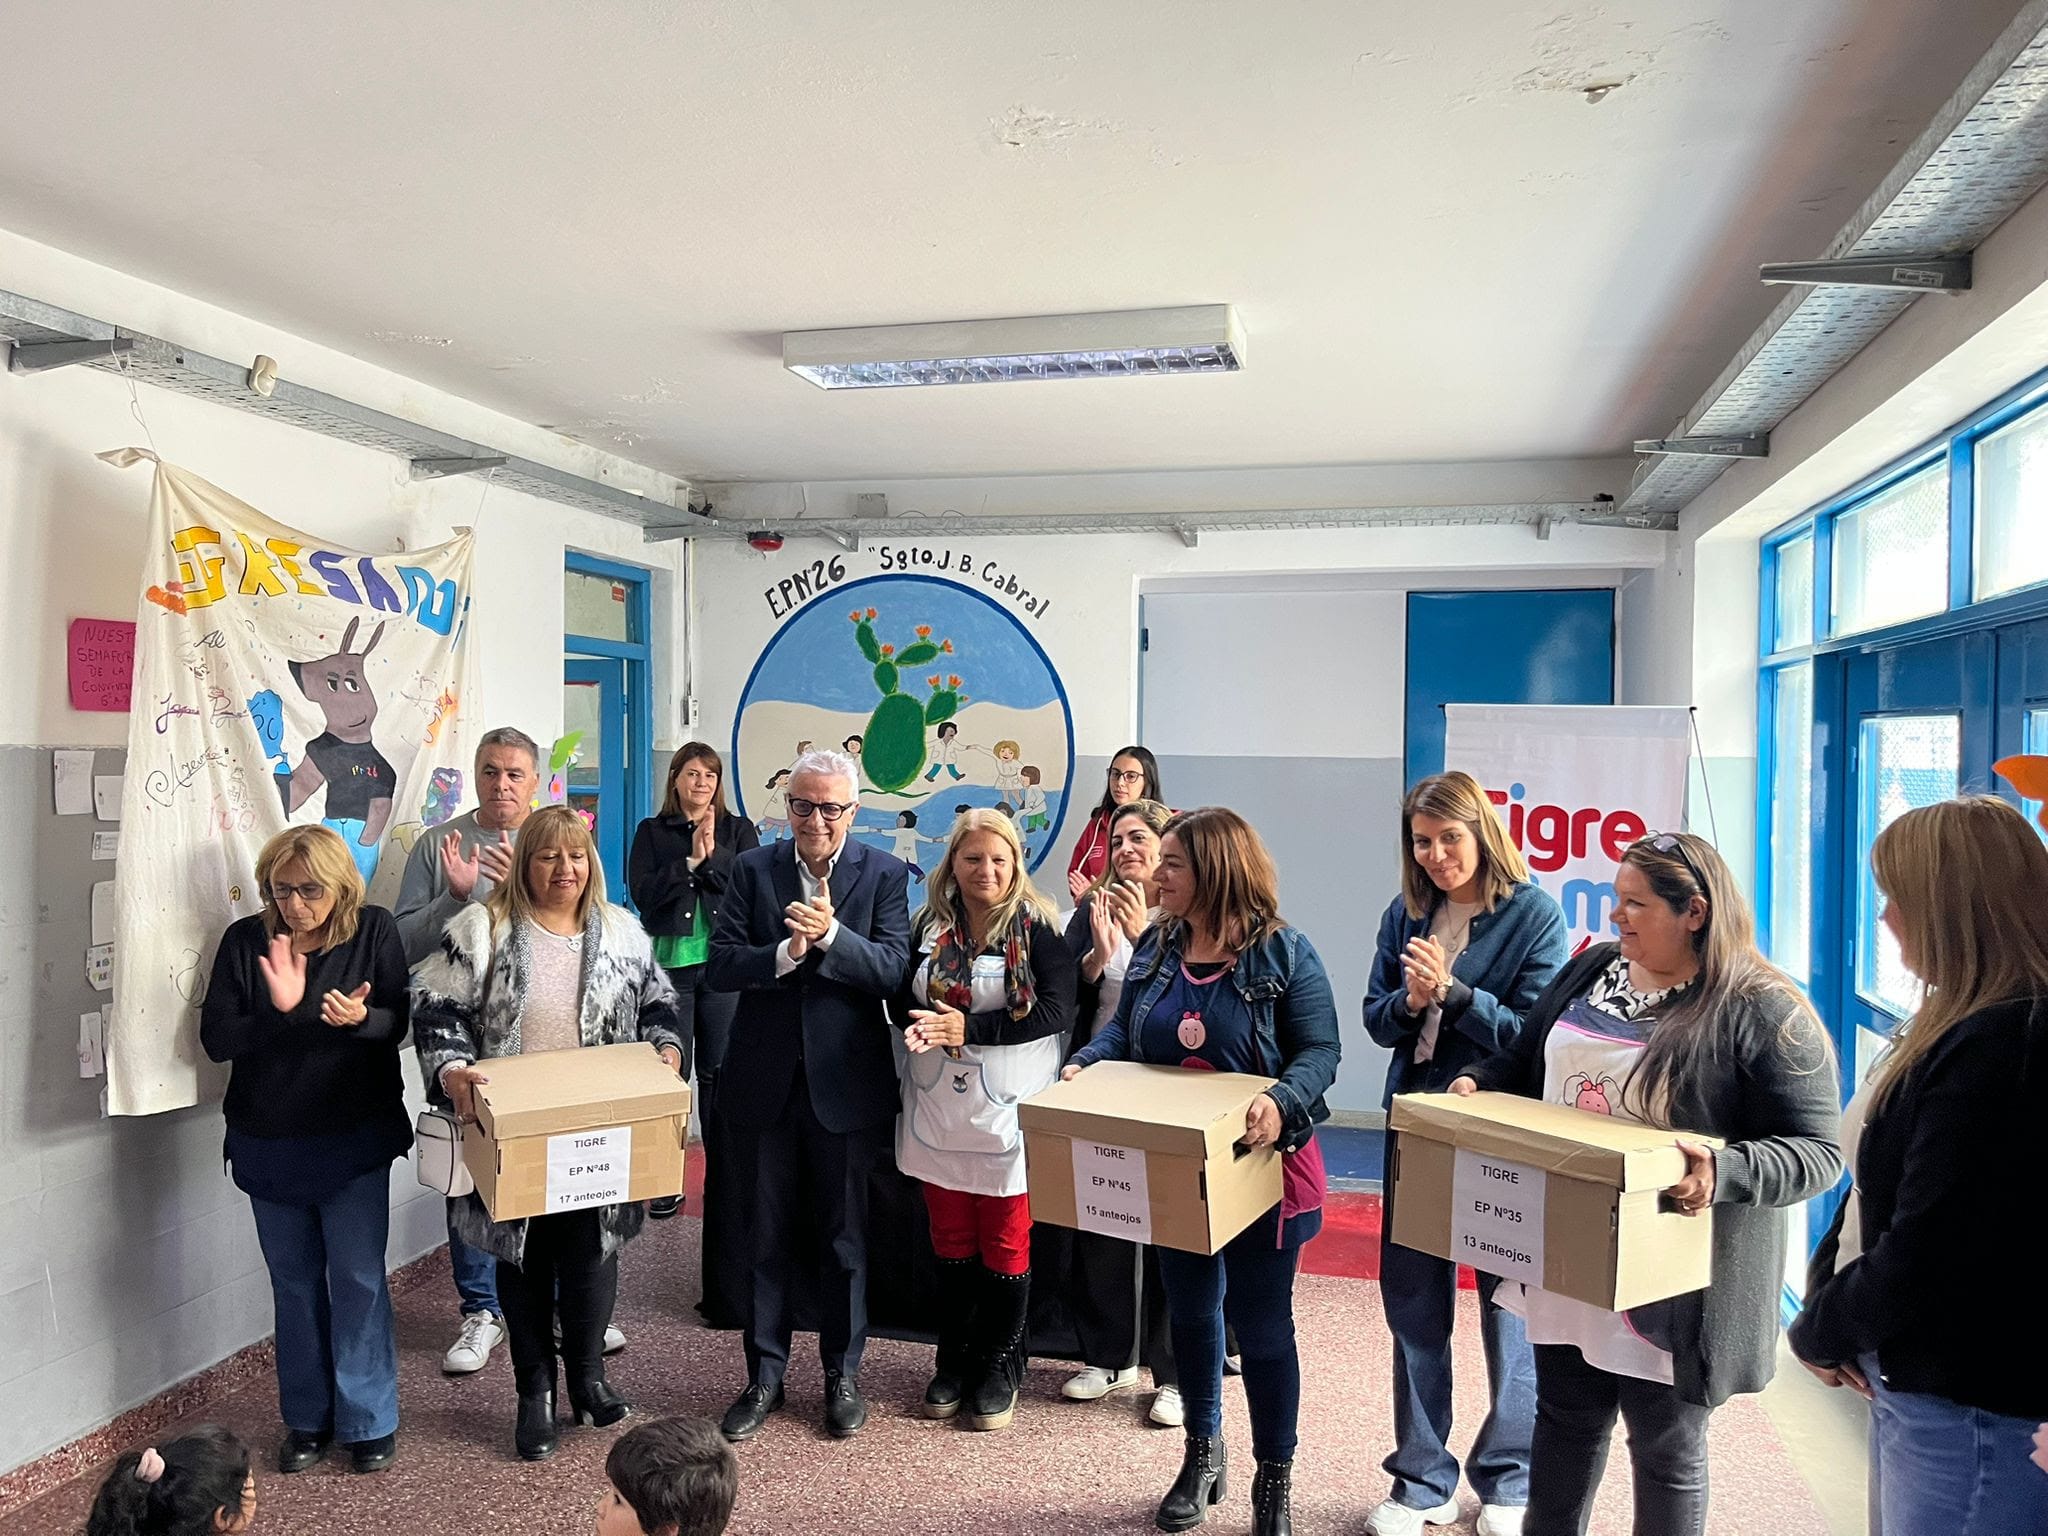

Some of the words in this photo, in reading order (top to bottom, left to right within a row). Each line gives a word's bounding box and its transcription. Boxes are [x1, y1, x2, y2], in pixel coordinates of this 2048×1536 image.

[982, 562, 1050, 619] Cabral
[87, 664, 103, 677] DE
[112, 667, 125, 675] LA
[1484, 782, 1647, 872] igre
[574, 1137, 607, 1148] TIGRE
[1094, 1146, 1125, 1160] TIGRE
[569, 1166, 583, 1176] EP
[1481, 1165, 1519, 1184] TIGRE
[1092, 1176, 1105, 1186] EP
[560, 1195, 571, 1203] 17
[574, 1189, 617, 1202] anteojos
[1474, 1200, 1490, 1213] EP
[1086, 1205, 1097, 1215] 15
[1099, 1209, 1141, 1224] anteojos
[1464, 1235, 1476, 1247] 13
[1479, 1242, 1532, 1263] anteojos
